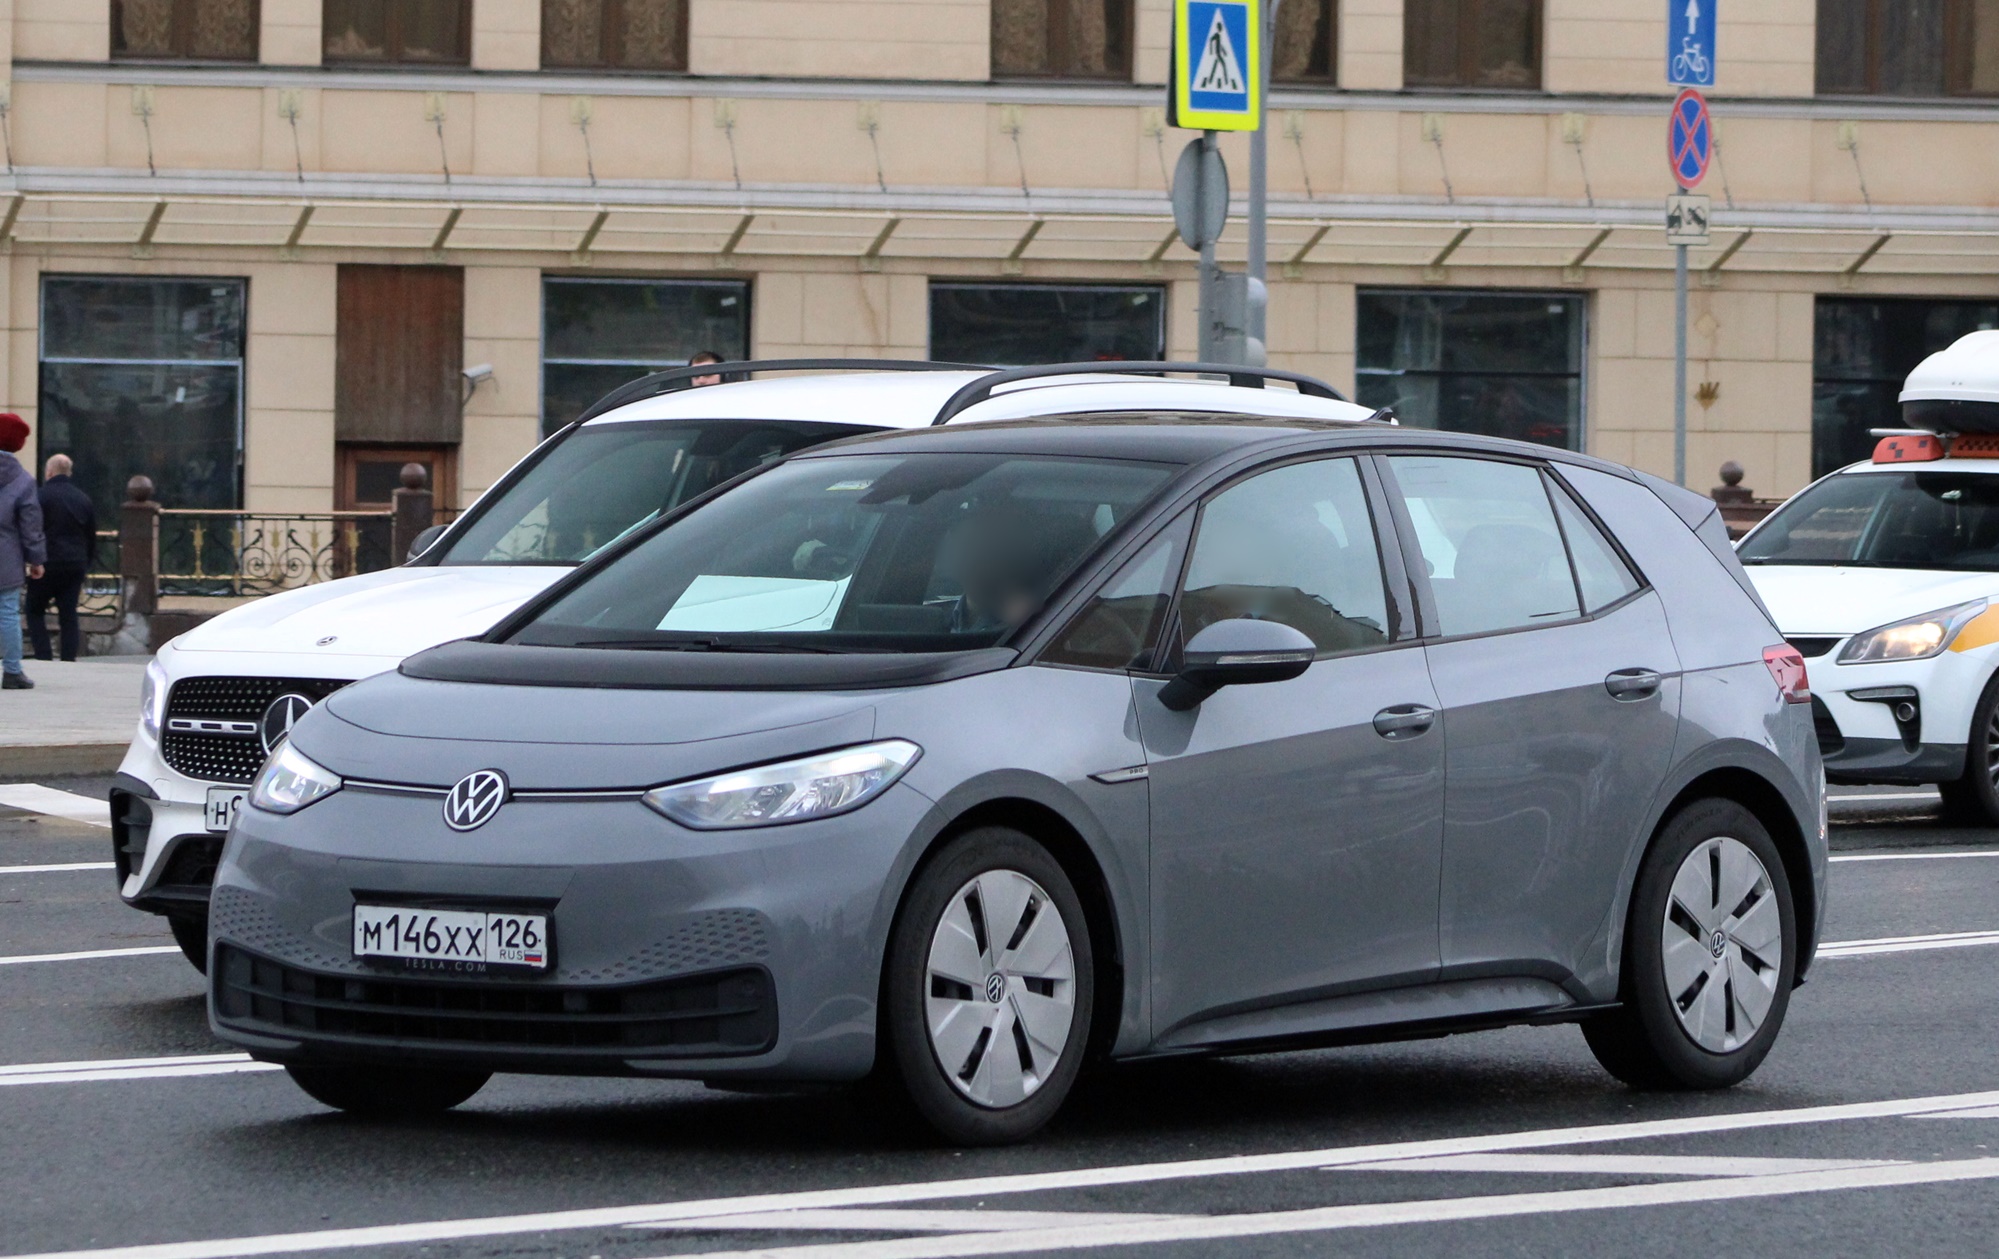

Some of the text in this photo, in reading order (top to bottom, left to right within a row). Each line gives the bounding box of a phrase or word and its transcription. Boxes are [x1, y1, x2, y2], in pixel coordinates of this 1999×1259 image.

[363, 914, 538, 957] М146ХХ 126
[499, 949, 524, 961] RUS
[405, 957, 487, 972] TESLA.COM
